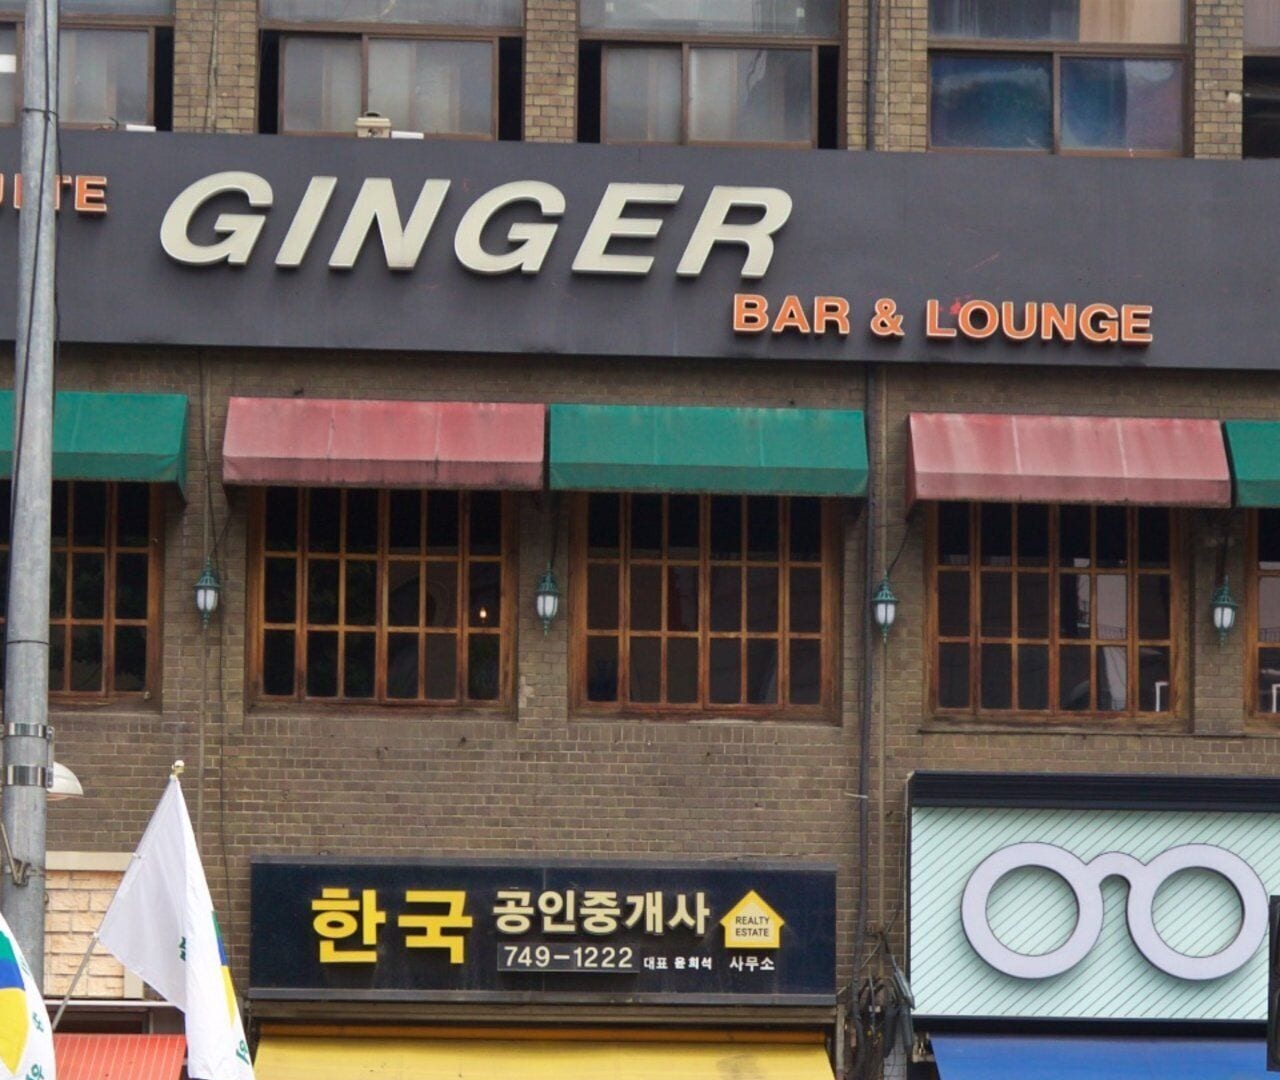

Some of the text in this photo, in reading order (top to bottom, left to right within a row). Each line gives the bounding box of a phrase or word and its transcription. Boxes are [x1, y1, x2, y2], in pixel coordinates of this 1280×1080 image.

[159, 170, 793, 280] GINGER
[733, 294, 1153, 343] BAR & LOUNGE
[492, 890, 710, 936] 공인중개사
[735, 915, 770, 927] REALTY
[311, 888, 473, 964] 한국
[735, 927, 769, 938] ESTATE
[504, 945, 633, 969] 749-1222
[644, 956, 668, 971] 대표
[729, 955, 775, 973] 사무소
